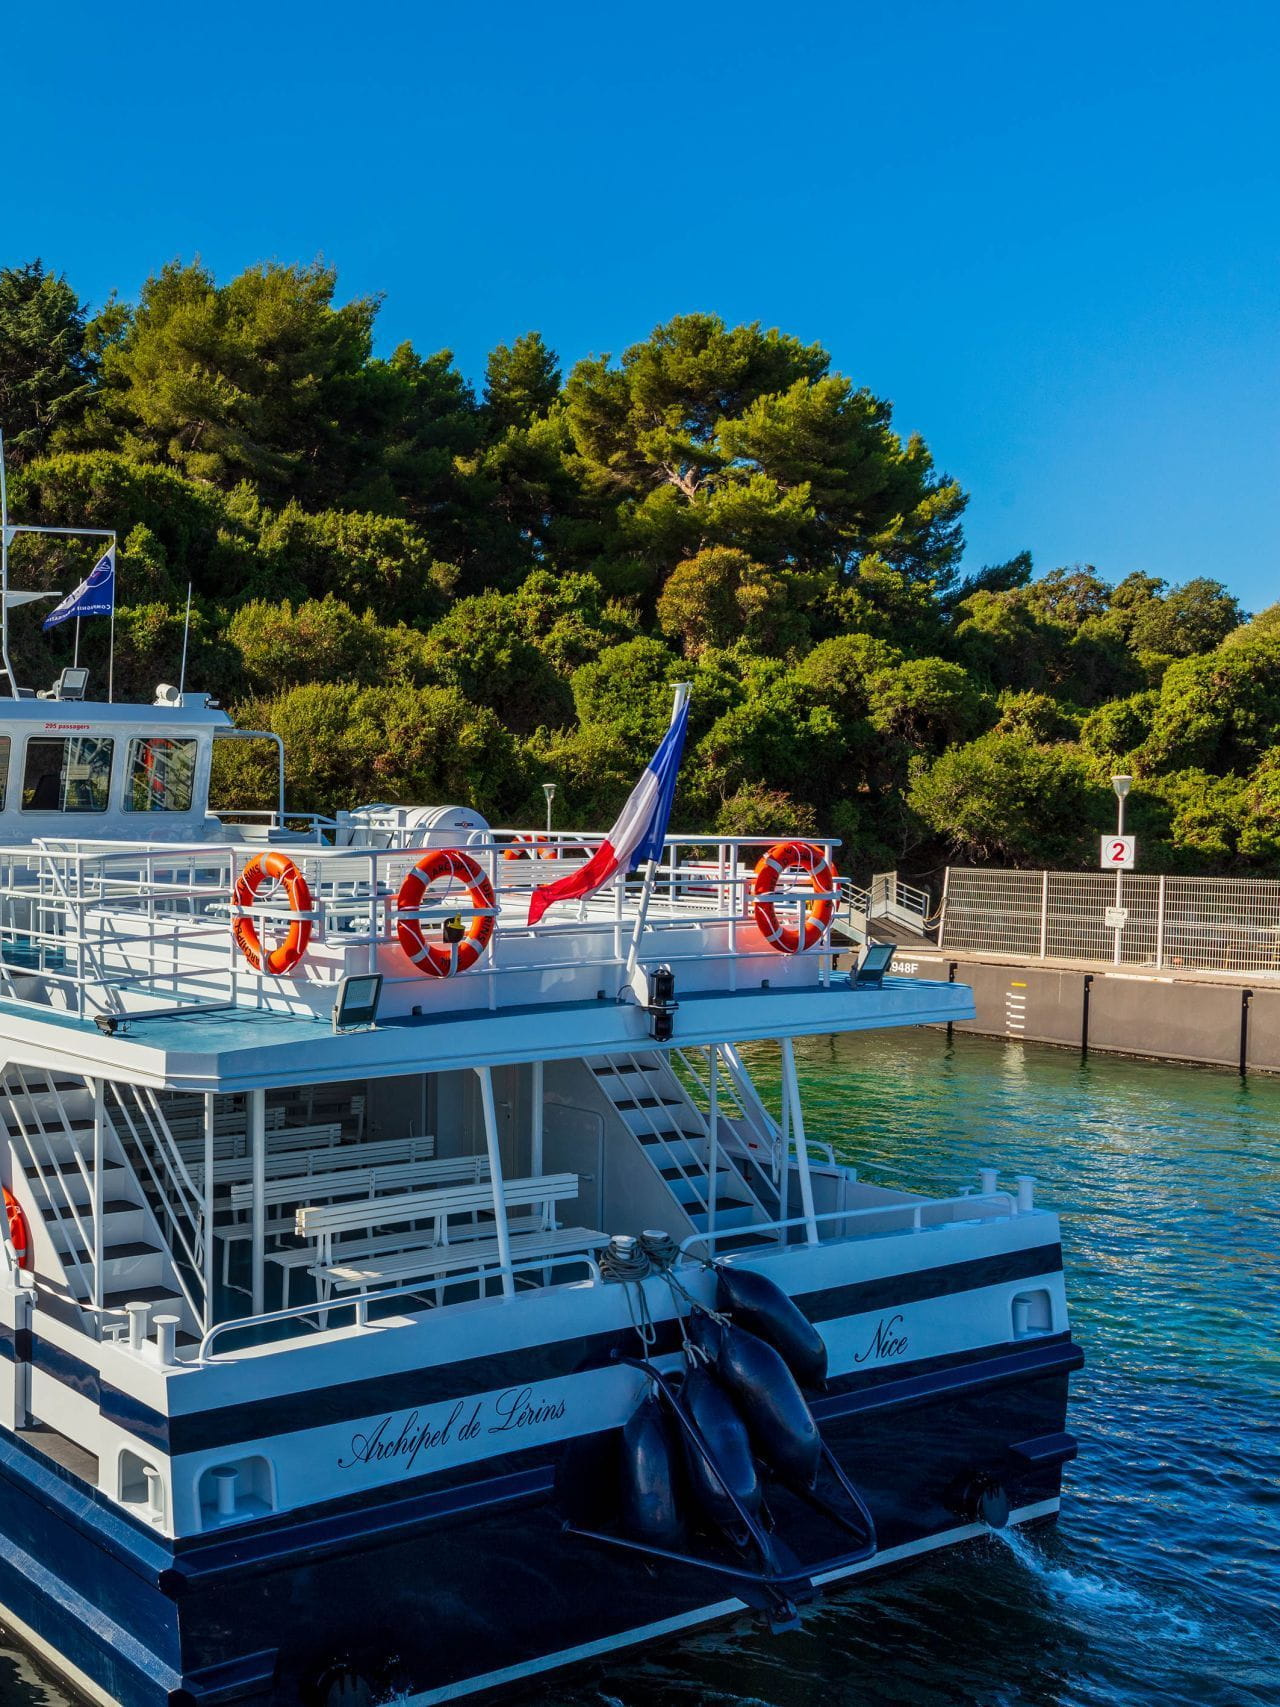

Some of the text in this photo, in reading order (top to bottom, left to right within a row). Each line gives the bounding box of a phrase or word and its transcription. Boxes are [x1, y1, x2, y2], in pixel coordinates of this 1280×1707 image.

[1112, 843, 1125, 861] 2
[854, 1314, 909, 1363] Nice
[337, 1387, 566, 1470] Archipel de Lérins
